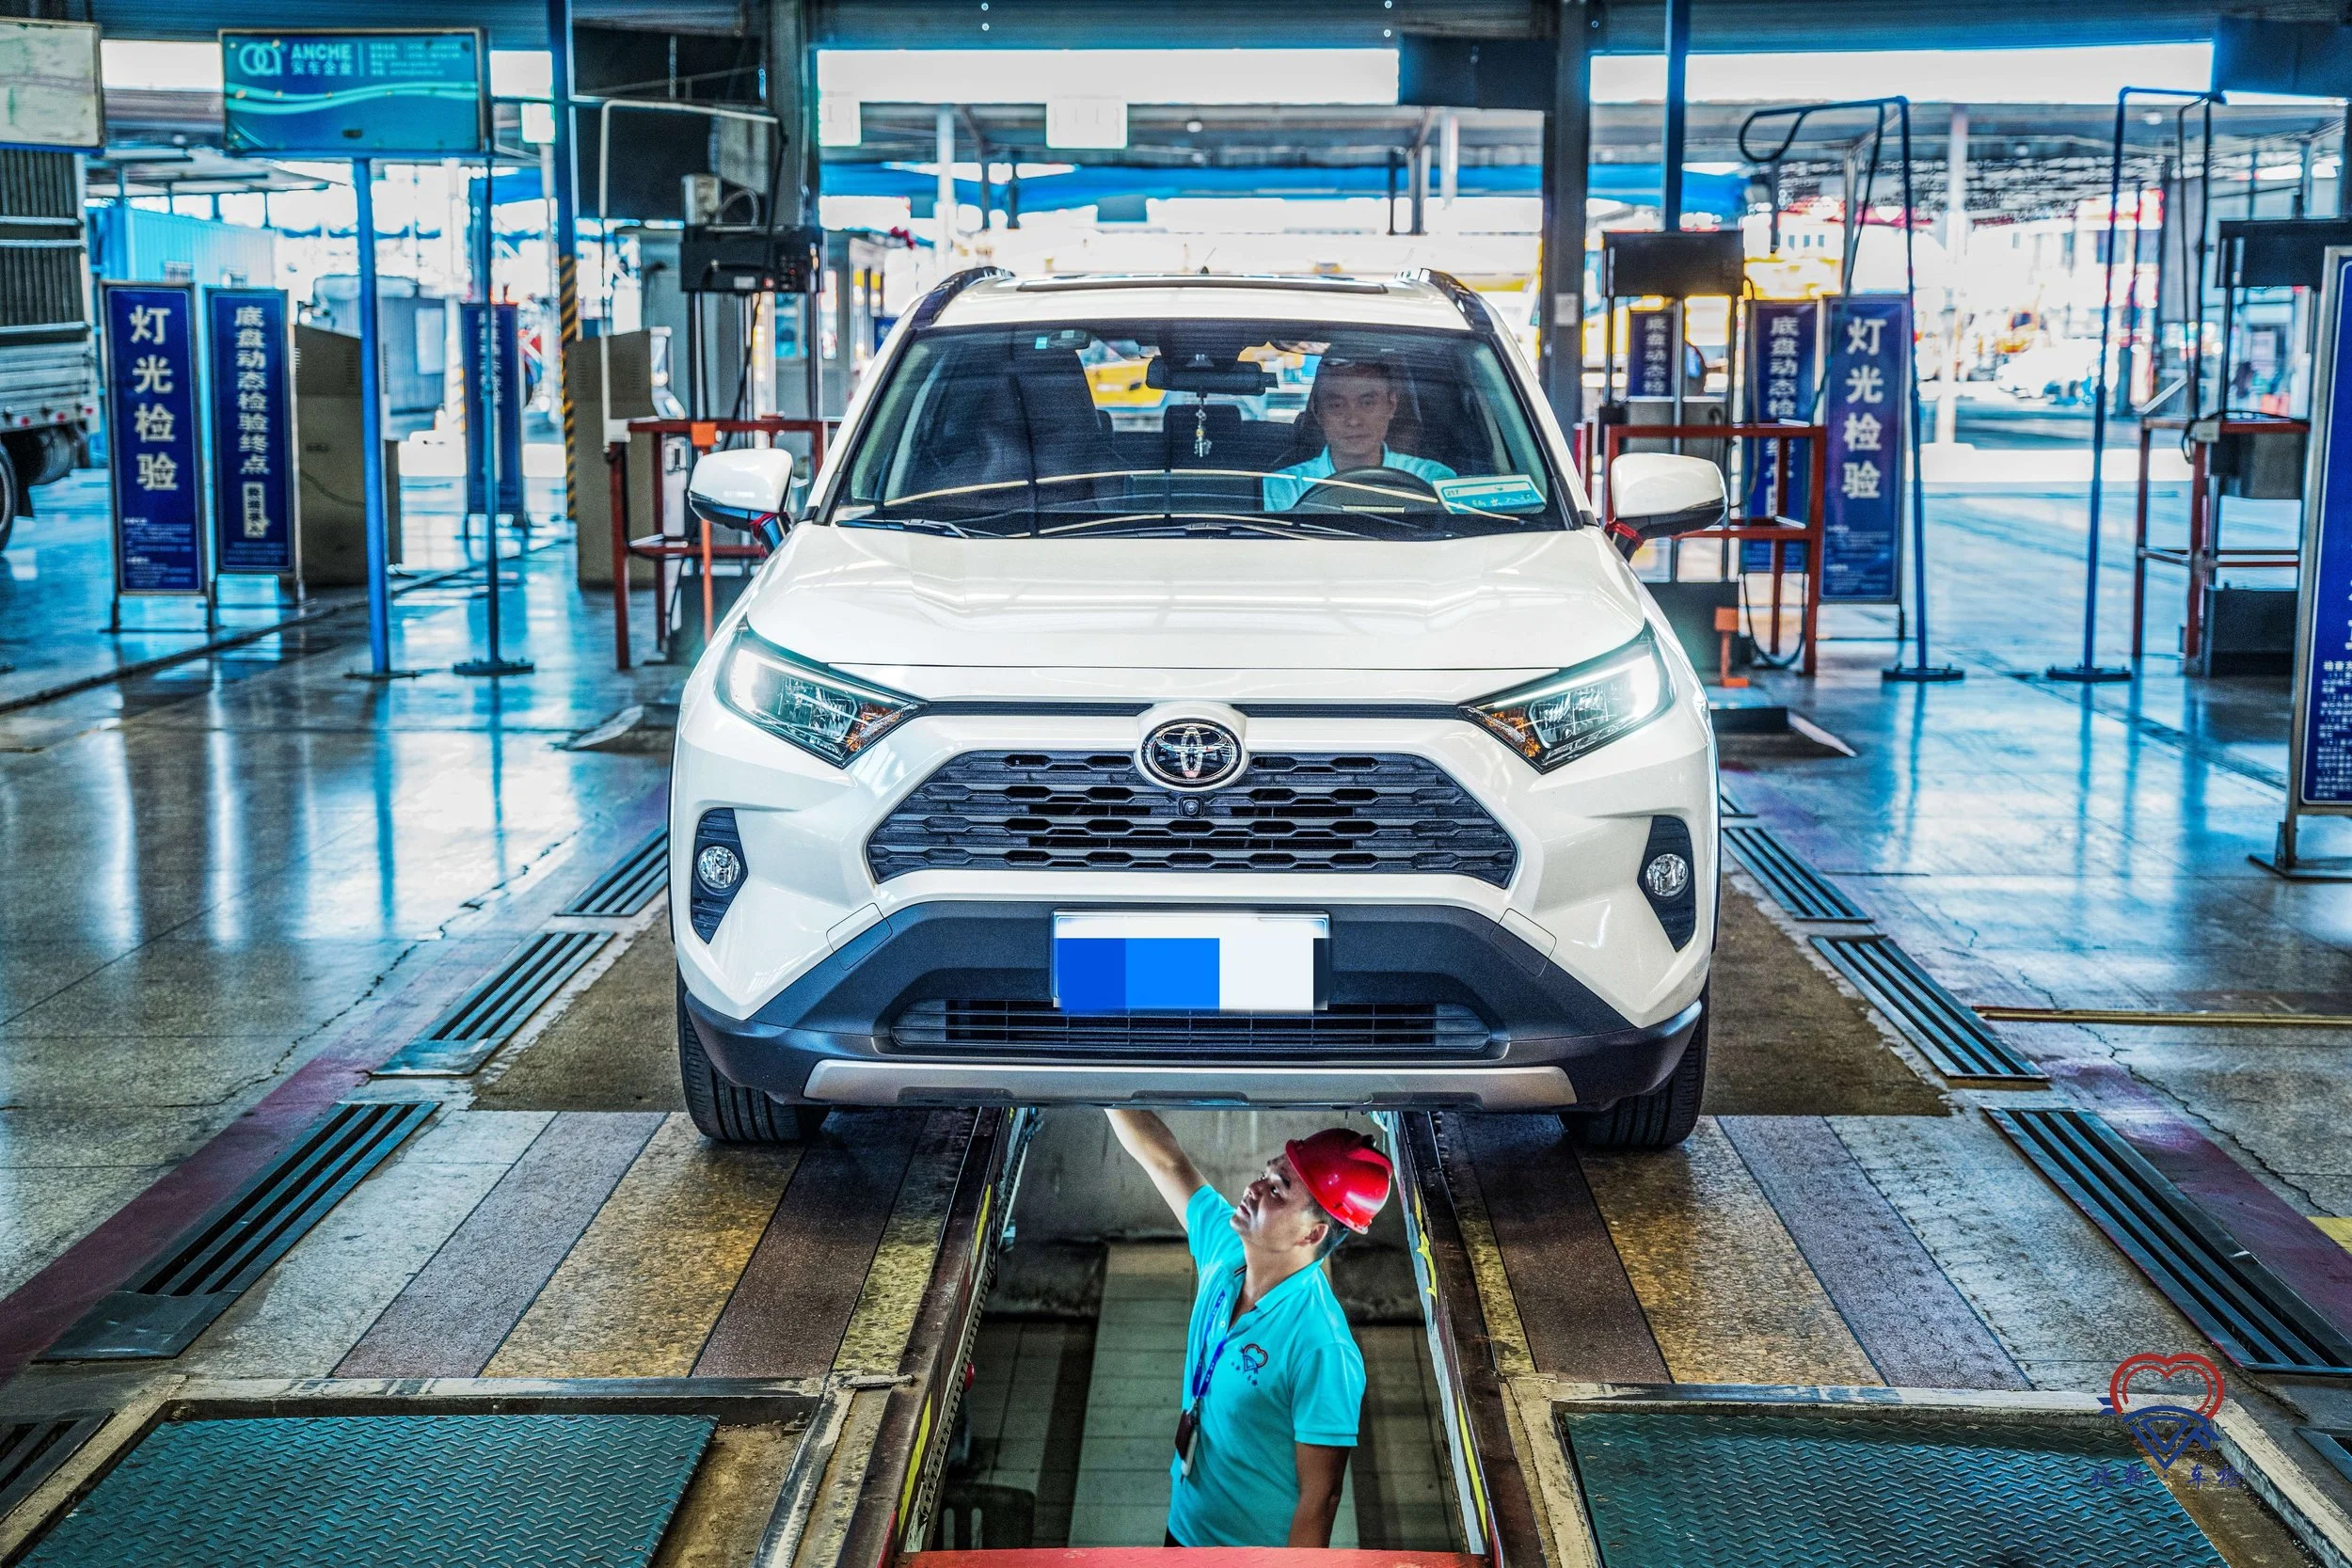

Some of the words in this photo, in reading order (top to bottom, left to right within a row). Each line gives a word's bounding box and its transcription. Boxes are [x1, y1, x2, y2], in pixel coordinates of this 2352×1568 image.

[129, 304, 179, 491] 灯光检验
[234, 305, 271, 475] 底盘动态检验终点
[1841, 316, 1886, 499] 灯光检验
